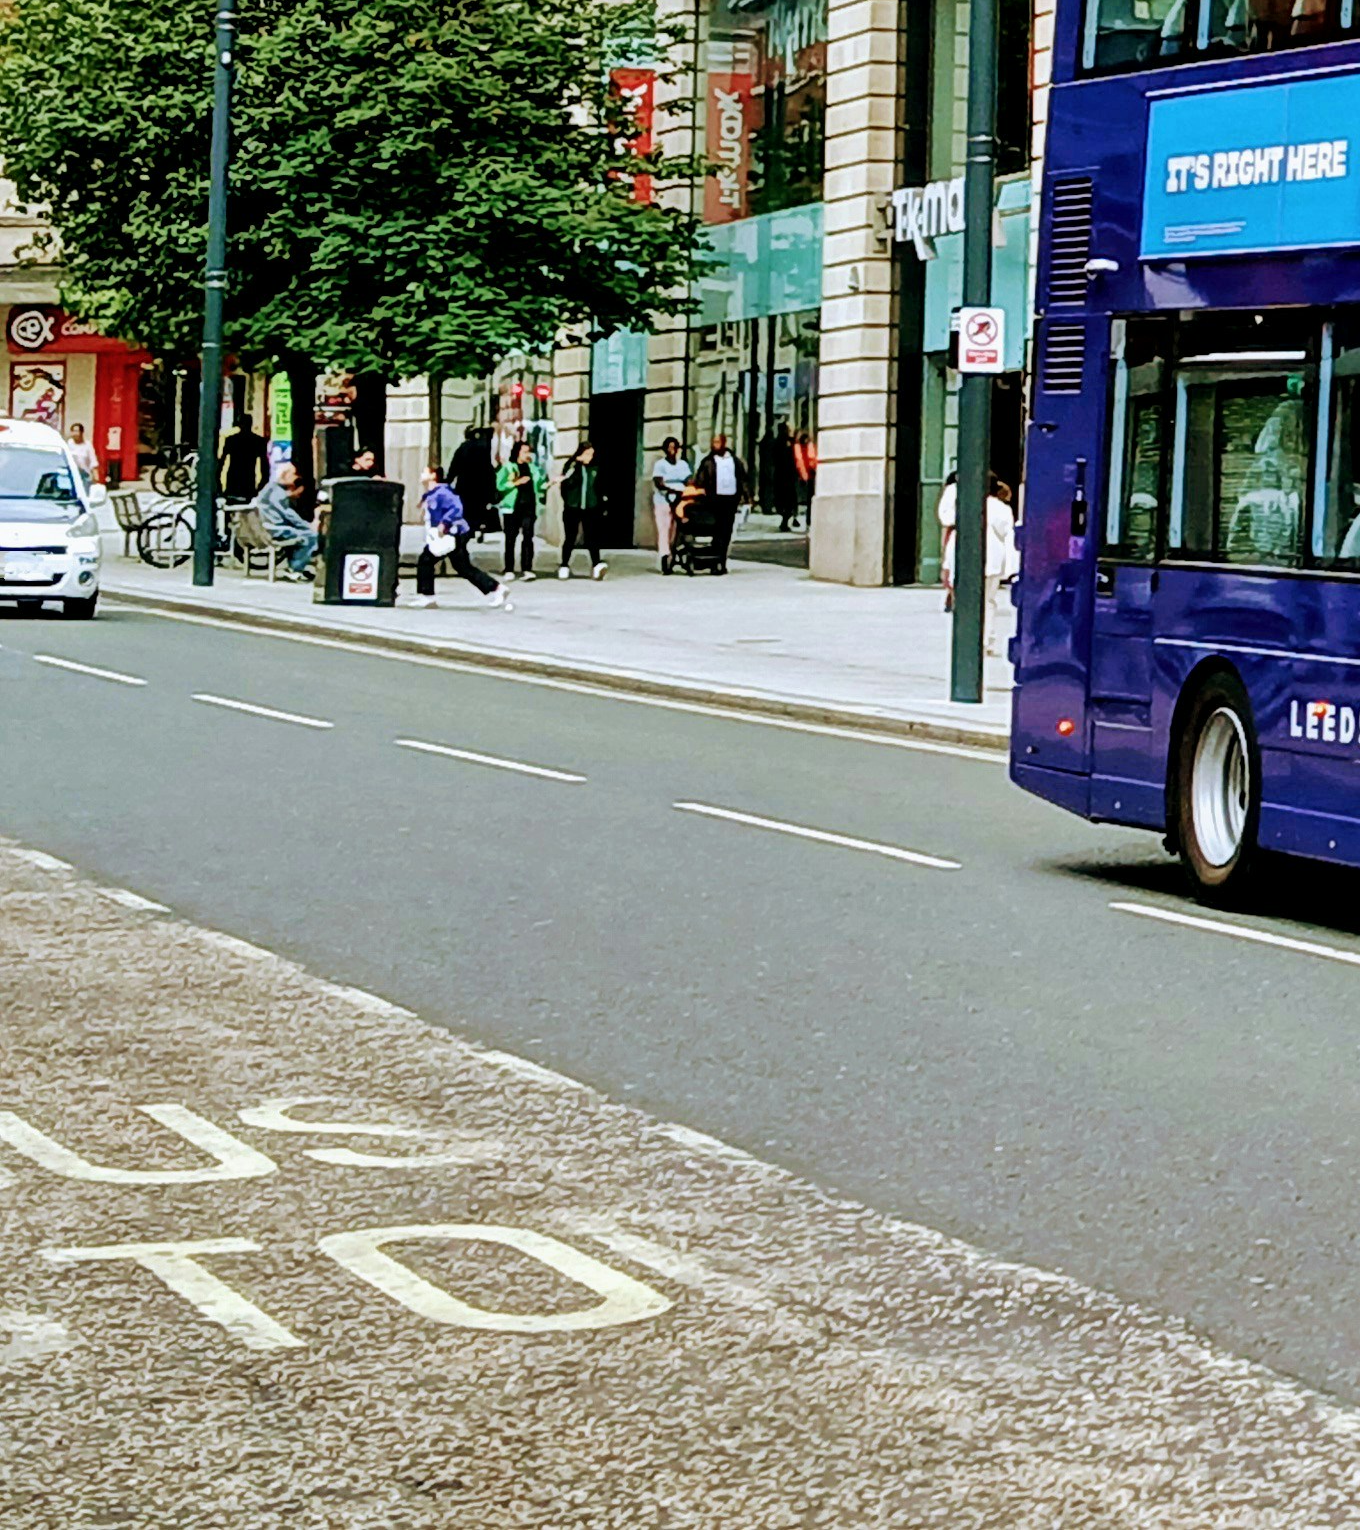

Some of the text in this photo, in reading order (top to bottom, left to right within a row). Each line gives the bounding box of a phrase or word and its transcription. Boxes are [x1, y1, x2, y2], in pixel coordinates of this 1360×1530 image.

[1166, 139, 1348, 193] IT'S RIGHT HERE
